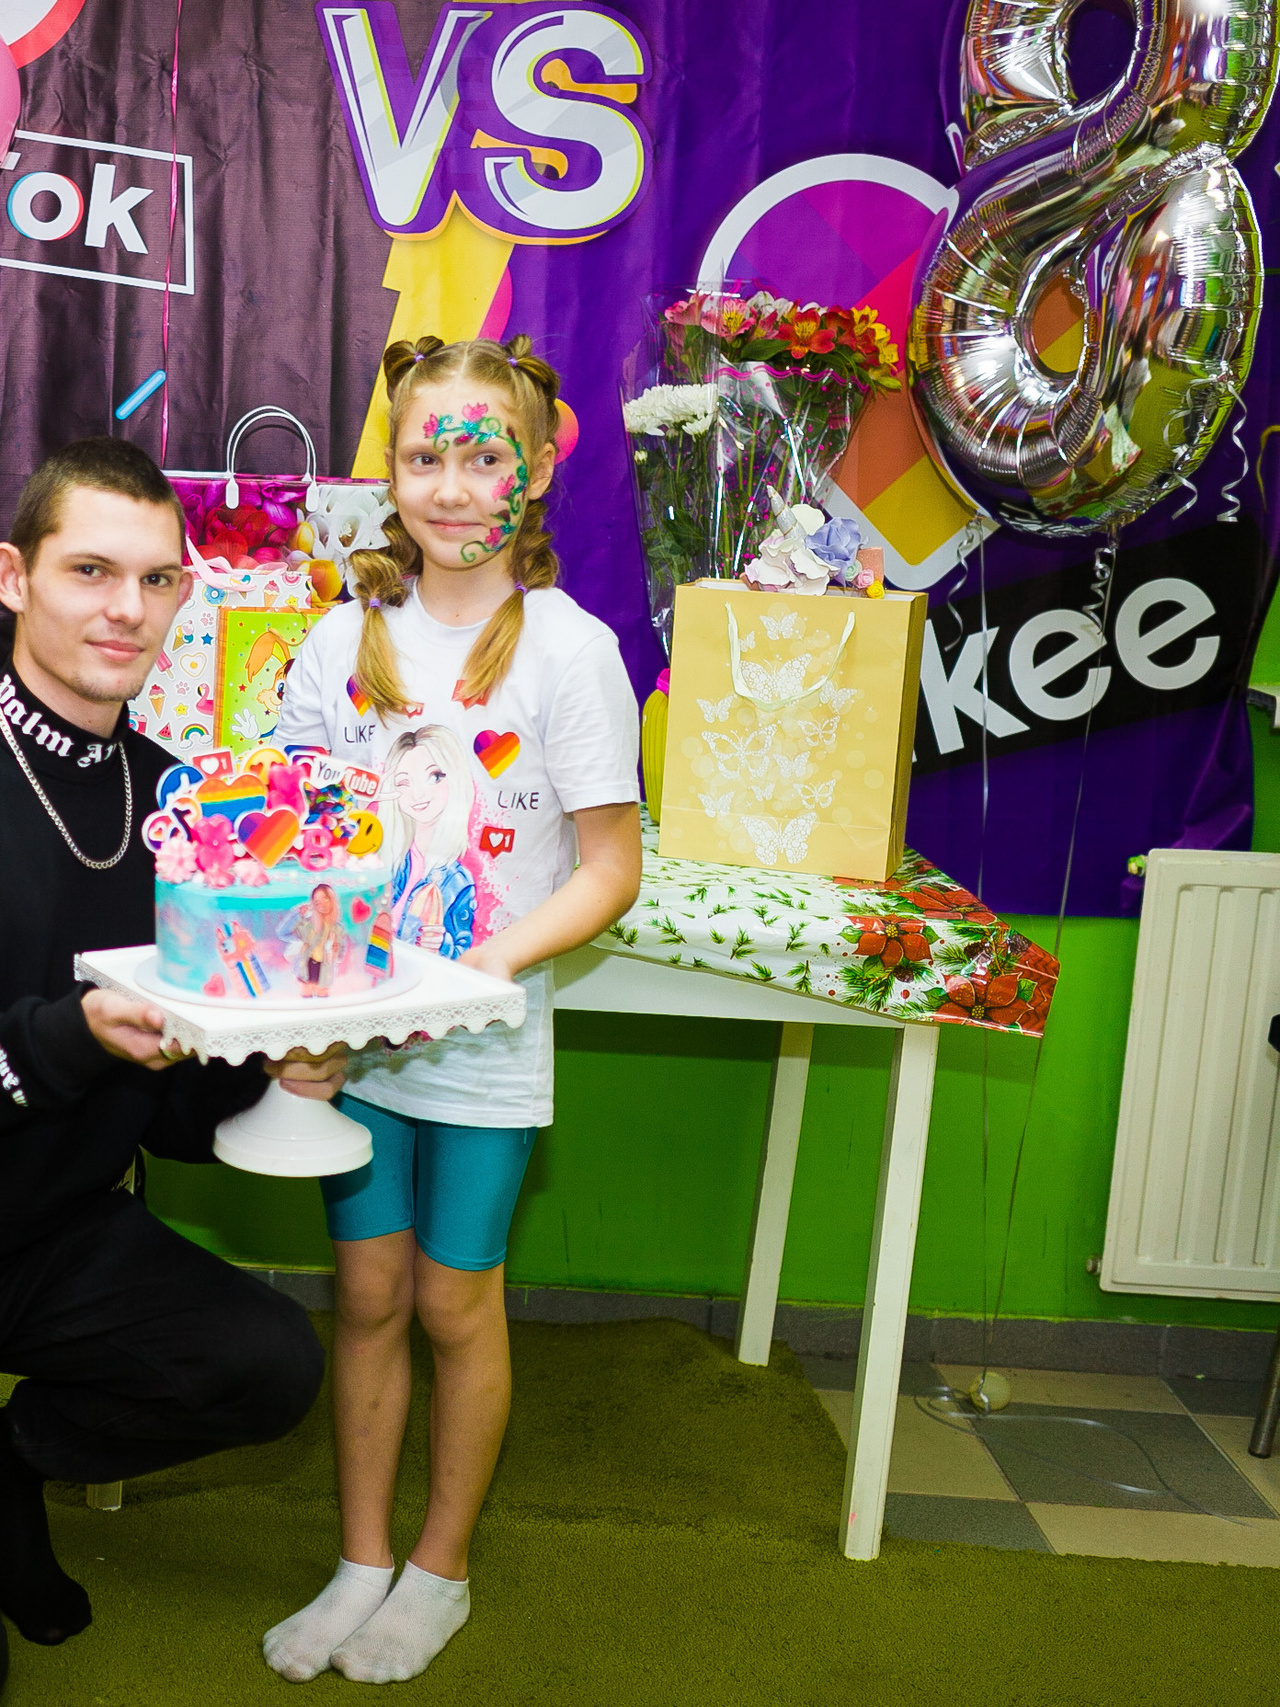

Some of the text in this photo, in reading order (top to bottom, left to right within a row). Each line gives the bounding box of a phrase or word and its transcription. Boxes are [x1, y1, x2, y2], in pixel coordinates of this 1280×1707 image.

[322, 7, 645, 231] VS
[913, 577, 1221, 762] kee
[344, 724, 376, 744] LIKE
[497, 790, 540, 811] LIKE
